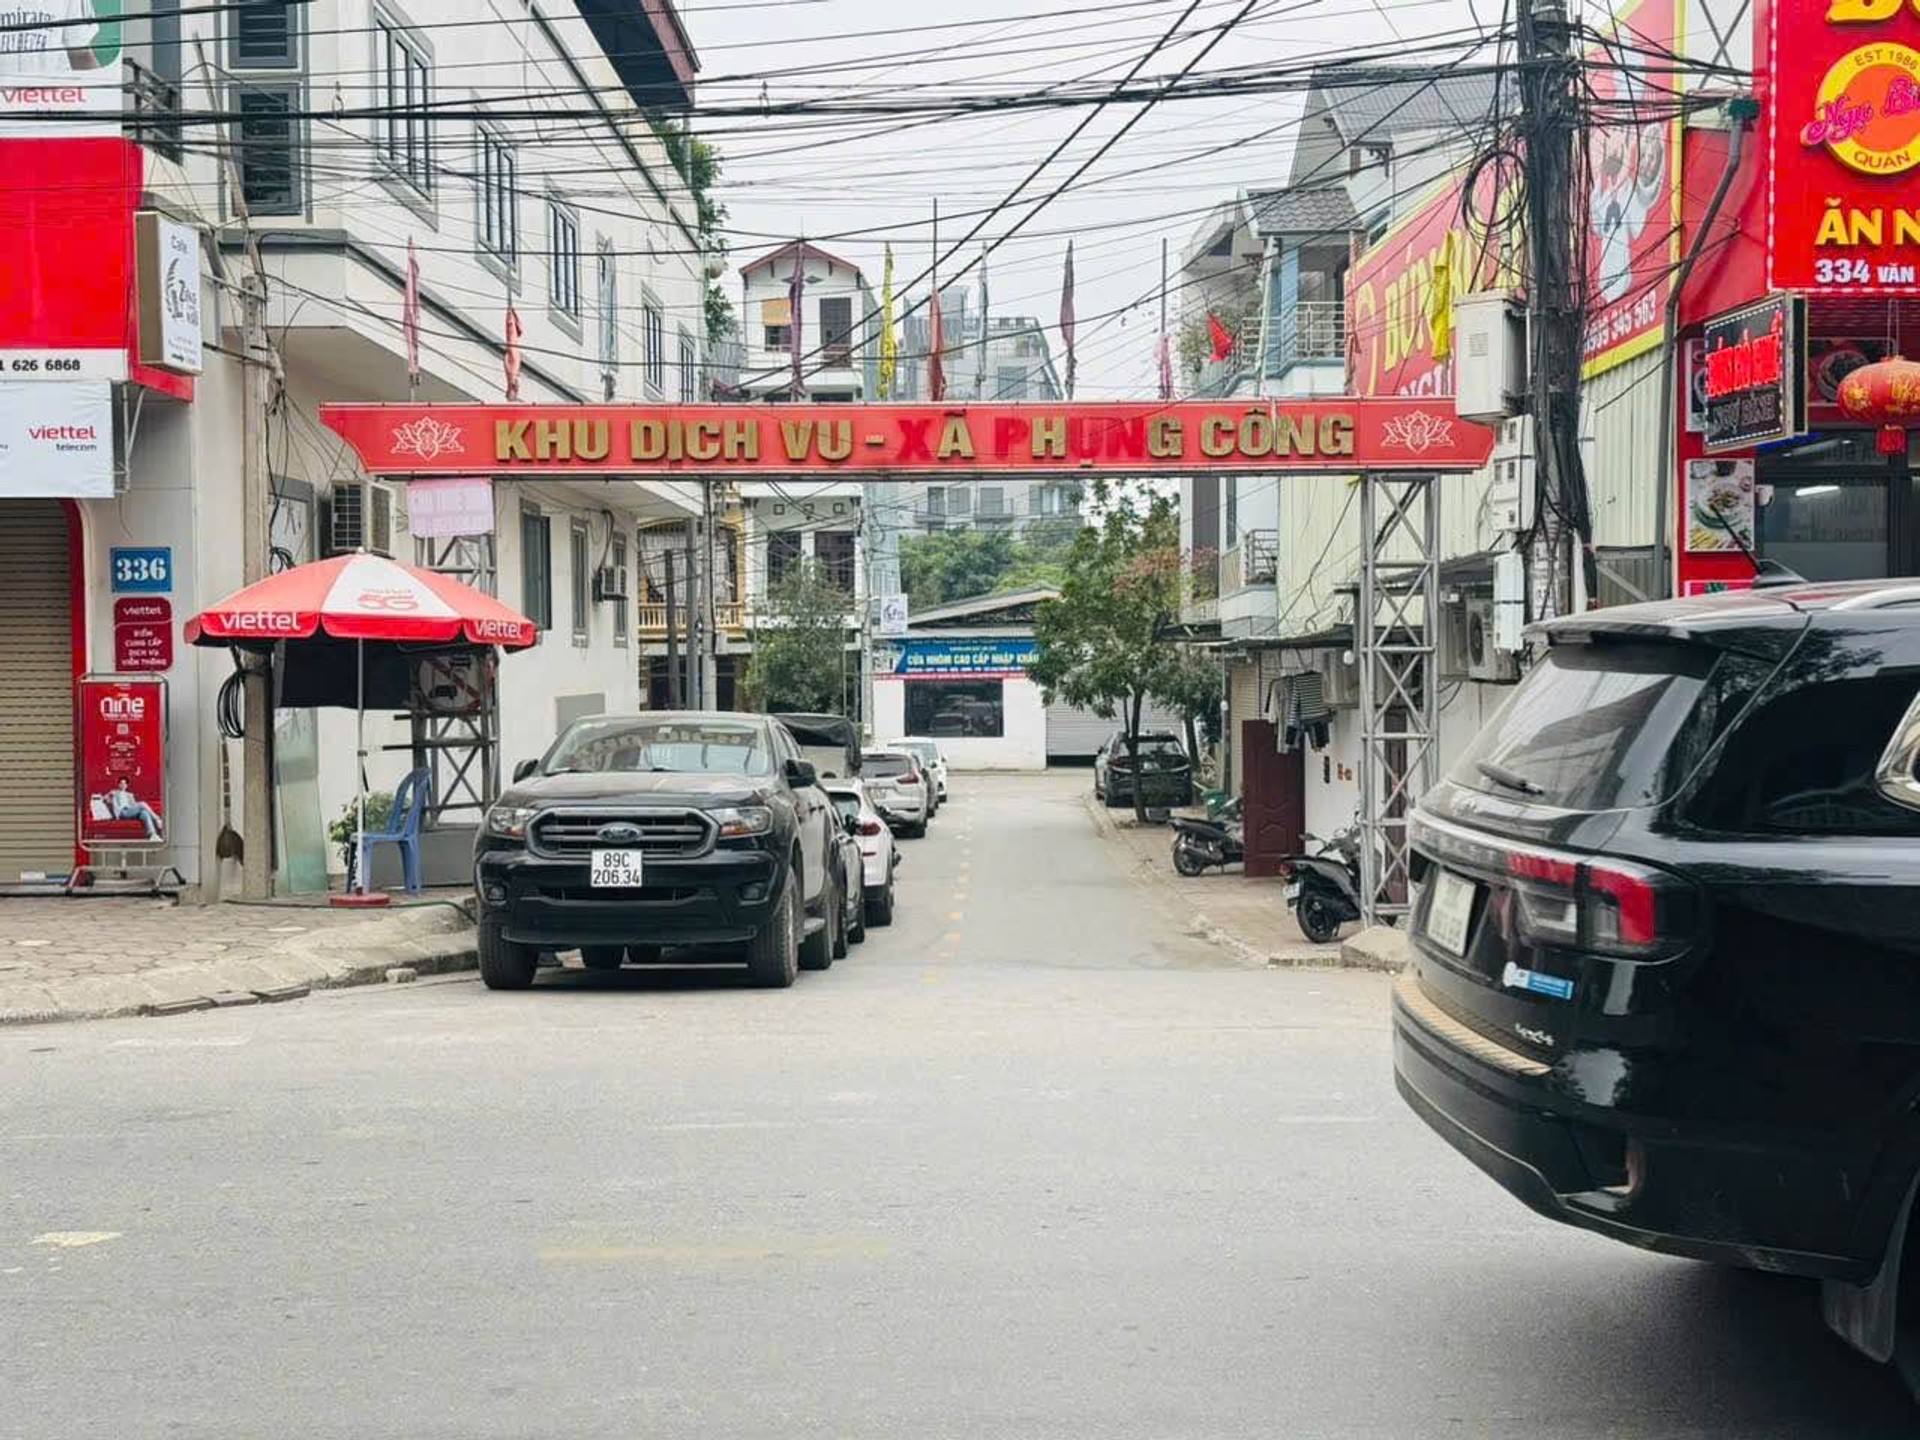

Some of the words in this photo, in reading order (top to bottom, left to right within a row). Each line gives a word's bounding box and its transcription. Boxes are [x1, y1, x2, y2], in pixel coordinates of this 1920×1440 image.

[1854, 50, 1883, 66] EST
[1814, 196, 1883, 246] ĂN
[1815, 259, 1870, 284] 334
[1877, 263, 1915, 283] VĂN
[12, 359, 38, 371] 626
[45, 359, 81, 371] 6868
[28, 425, 97, 439] viettel
[494, 419, 611, 462] KHU
[1200, 408, 1355, 458] CÔNG
[56, 443, 97, 451] telecom
[117, 557, 166, 581] 336
[123, 606, 162, 615] viettel
[219, 611, 301, 631] viettel
[474, 617, 523, 639] viettel
[603, 852, 630, 868] 89C
[593, 869, 640, 885] 206.34
